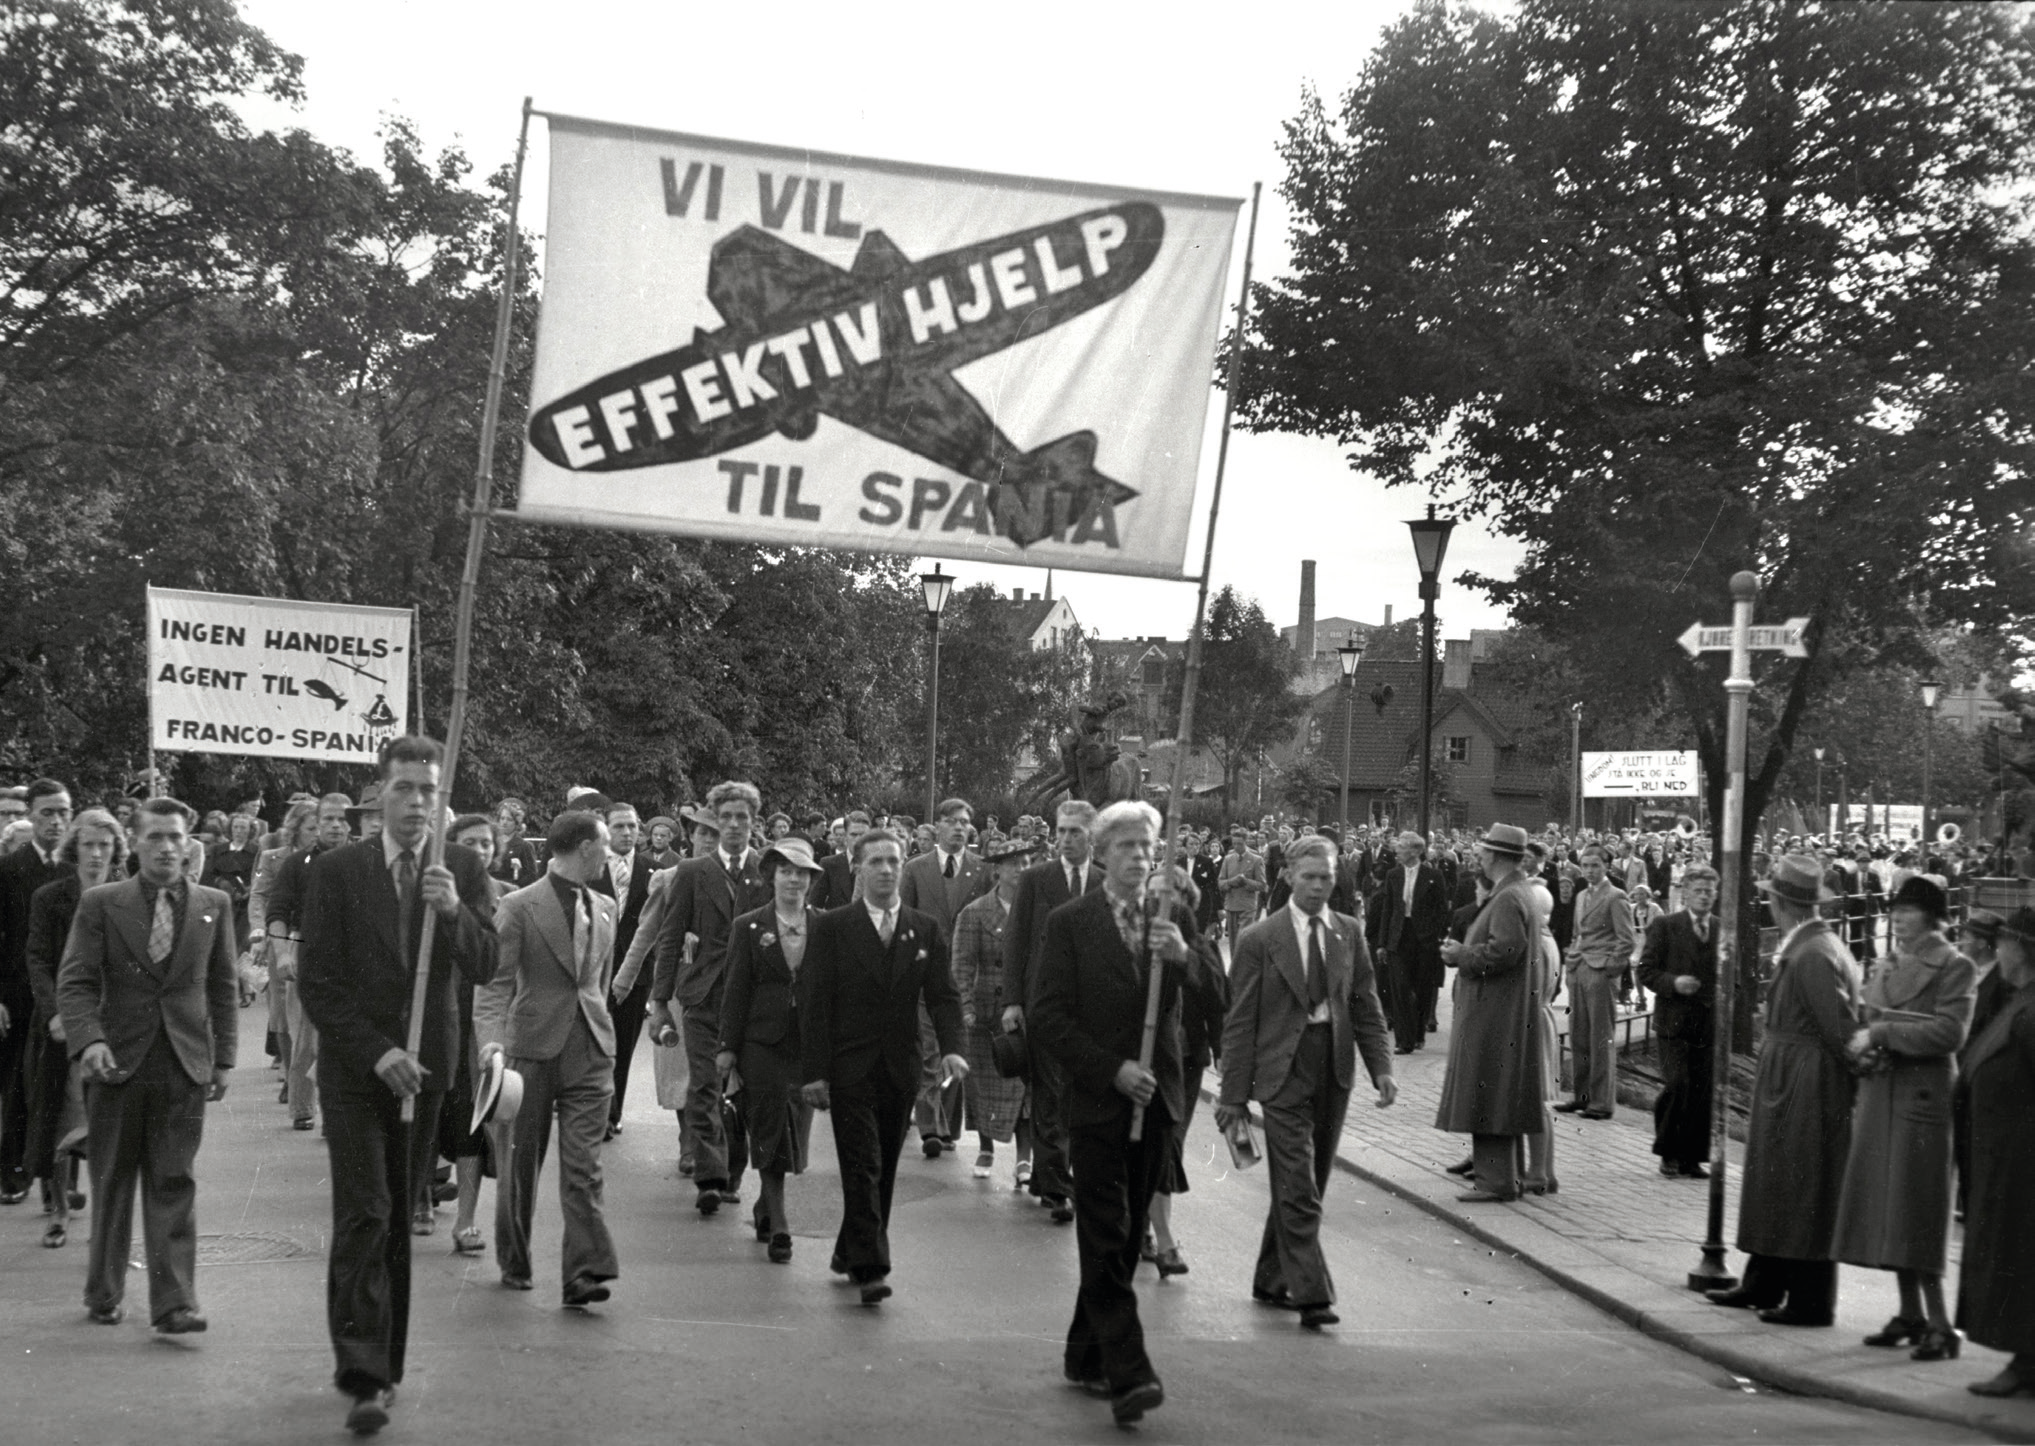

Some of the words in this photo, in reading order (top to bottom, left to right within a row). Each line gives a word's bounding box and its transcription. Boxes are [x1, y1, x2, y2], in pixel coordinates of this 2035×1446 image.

[660, 158, 725, 220] VI
[757, 170, 863, 240] VIL
[551, 302, 882, 469] EFFEKTIV
[904, 213, 1129, 343] HJELP
[717, 460, 822, 522] TIL
[857, 472, 1121, 550] SPANIA
[161, 619, 246, 647] INGEN
[264, 629, 404, 659] HANDELS-
[158, 663, 247, 691] AGENT
[262, 674, 299, 696] TIL
[1626, 769, 1646, 778] IKKE
[1649, 769, 1662, 778] OG
[1665, 755, 1687, 767] LAG
